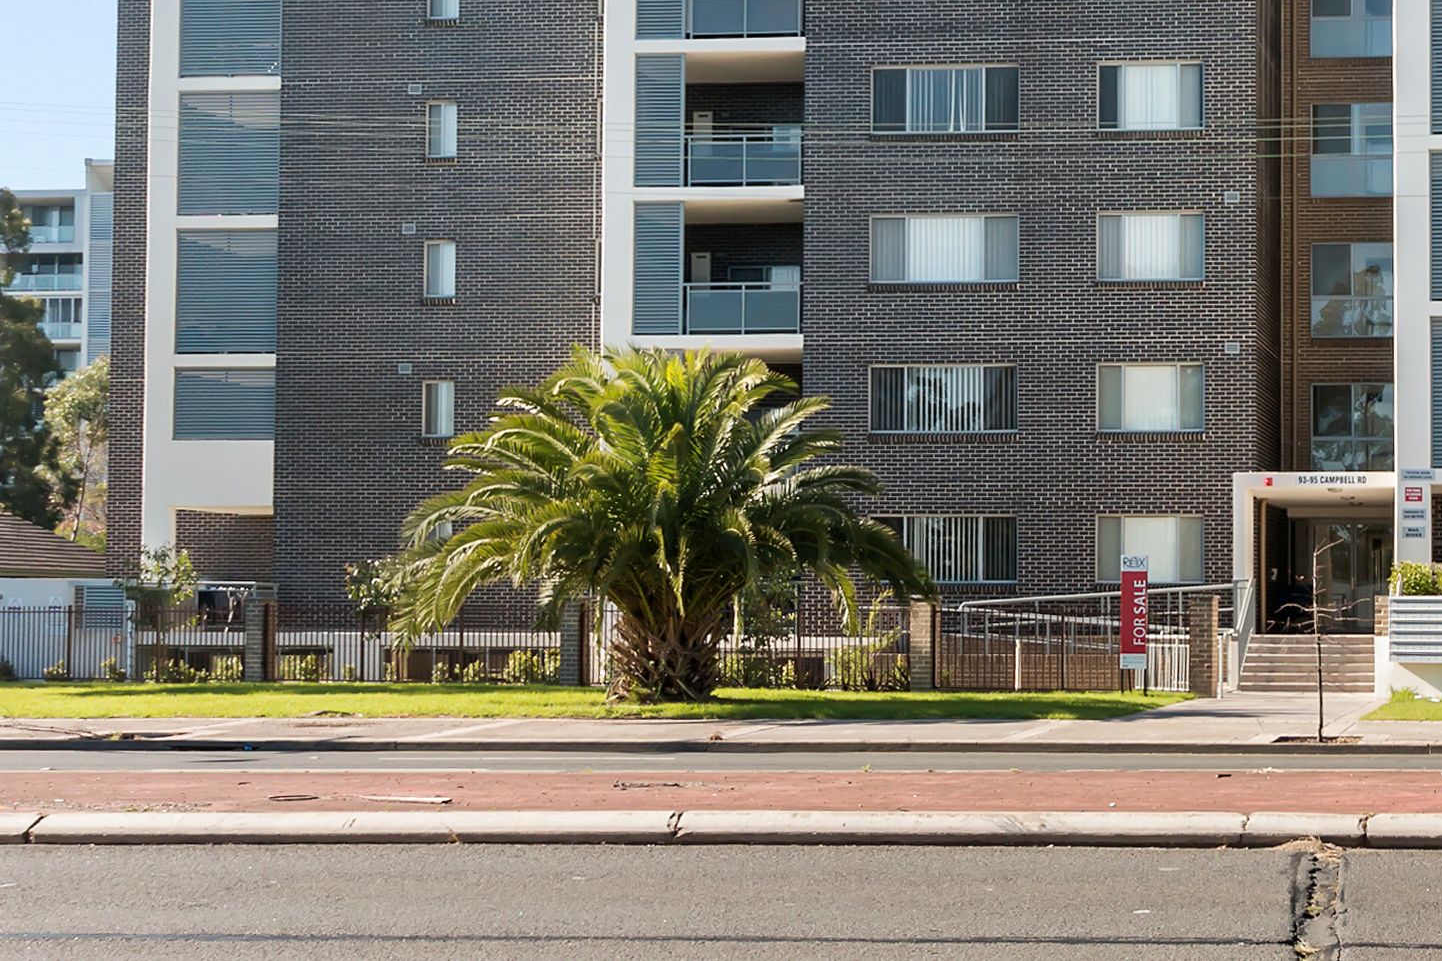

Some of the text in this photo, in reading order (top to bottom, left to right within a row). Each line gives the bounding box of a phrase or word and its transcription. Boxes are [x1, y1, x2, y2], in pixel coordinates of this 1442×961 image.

[1298, 476, 1367, 484] 93-95 CAMPBELL RD
[1133, 580, 1146, 614] SALE
[1133, 618, 1146, 646] FOR
